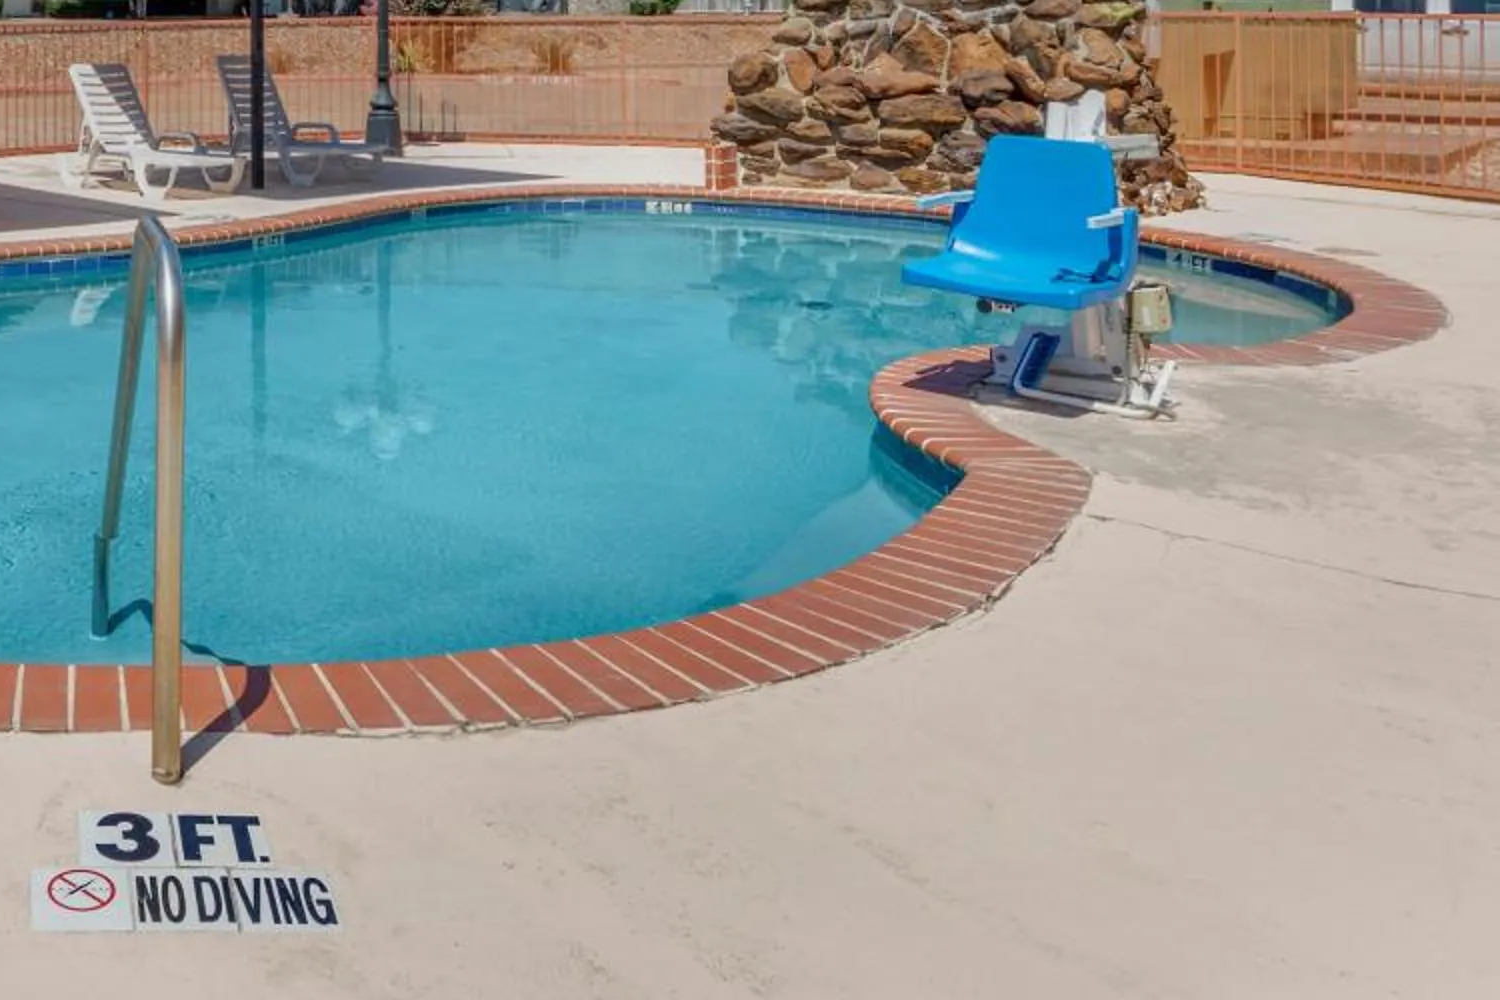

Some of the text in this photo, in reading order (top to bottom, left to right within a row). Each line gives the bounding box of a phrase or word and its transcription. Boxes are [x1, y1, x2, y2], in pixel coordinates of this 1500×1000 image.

[95, 812, 270, 863] 3 FT.
[135, 875, 339, 925] NO DIVING
